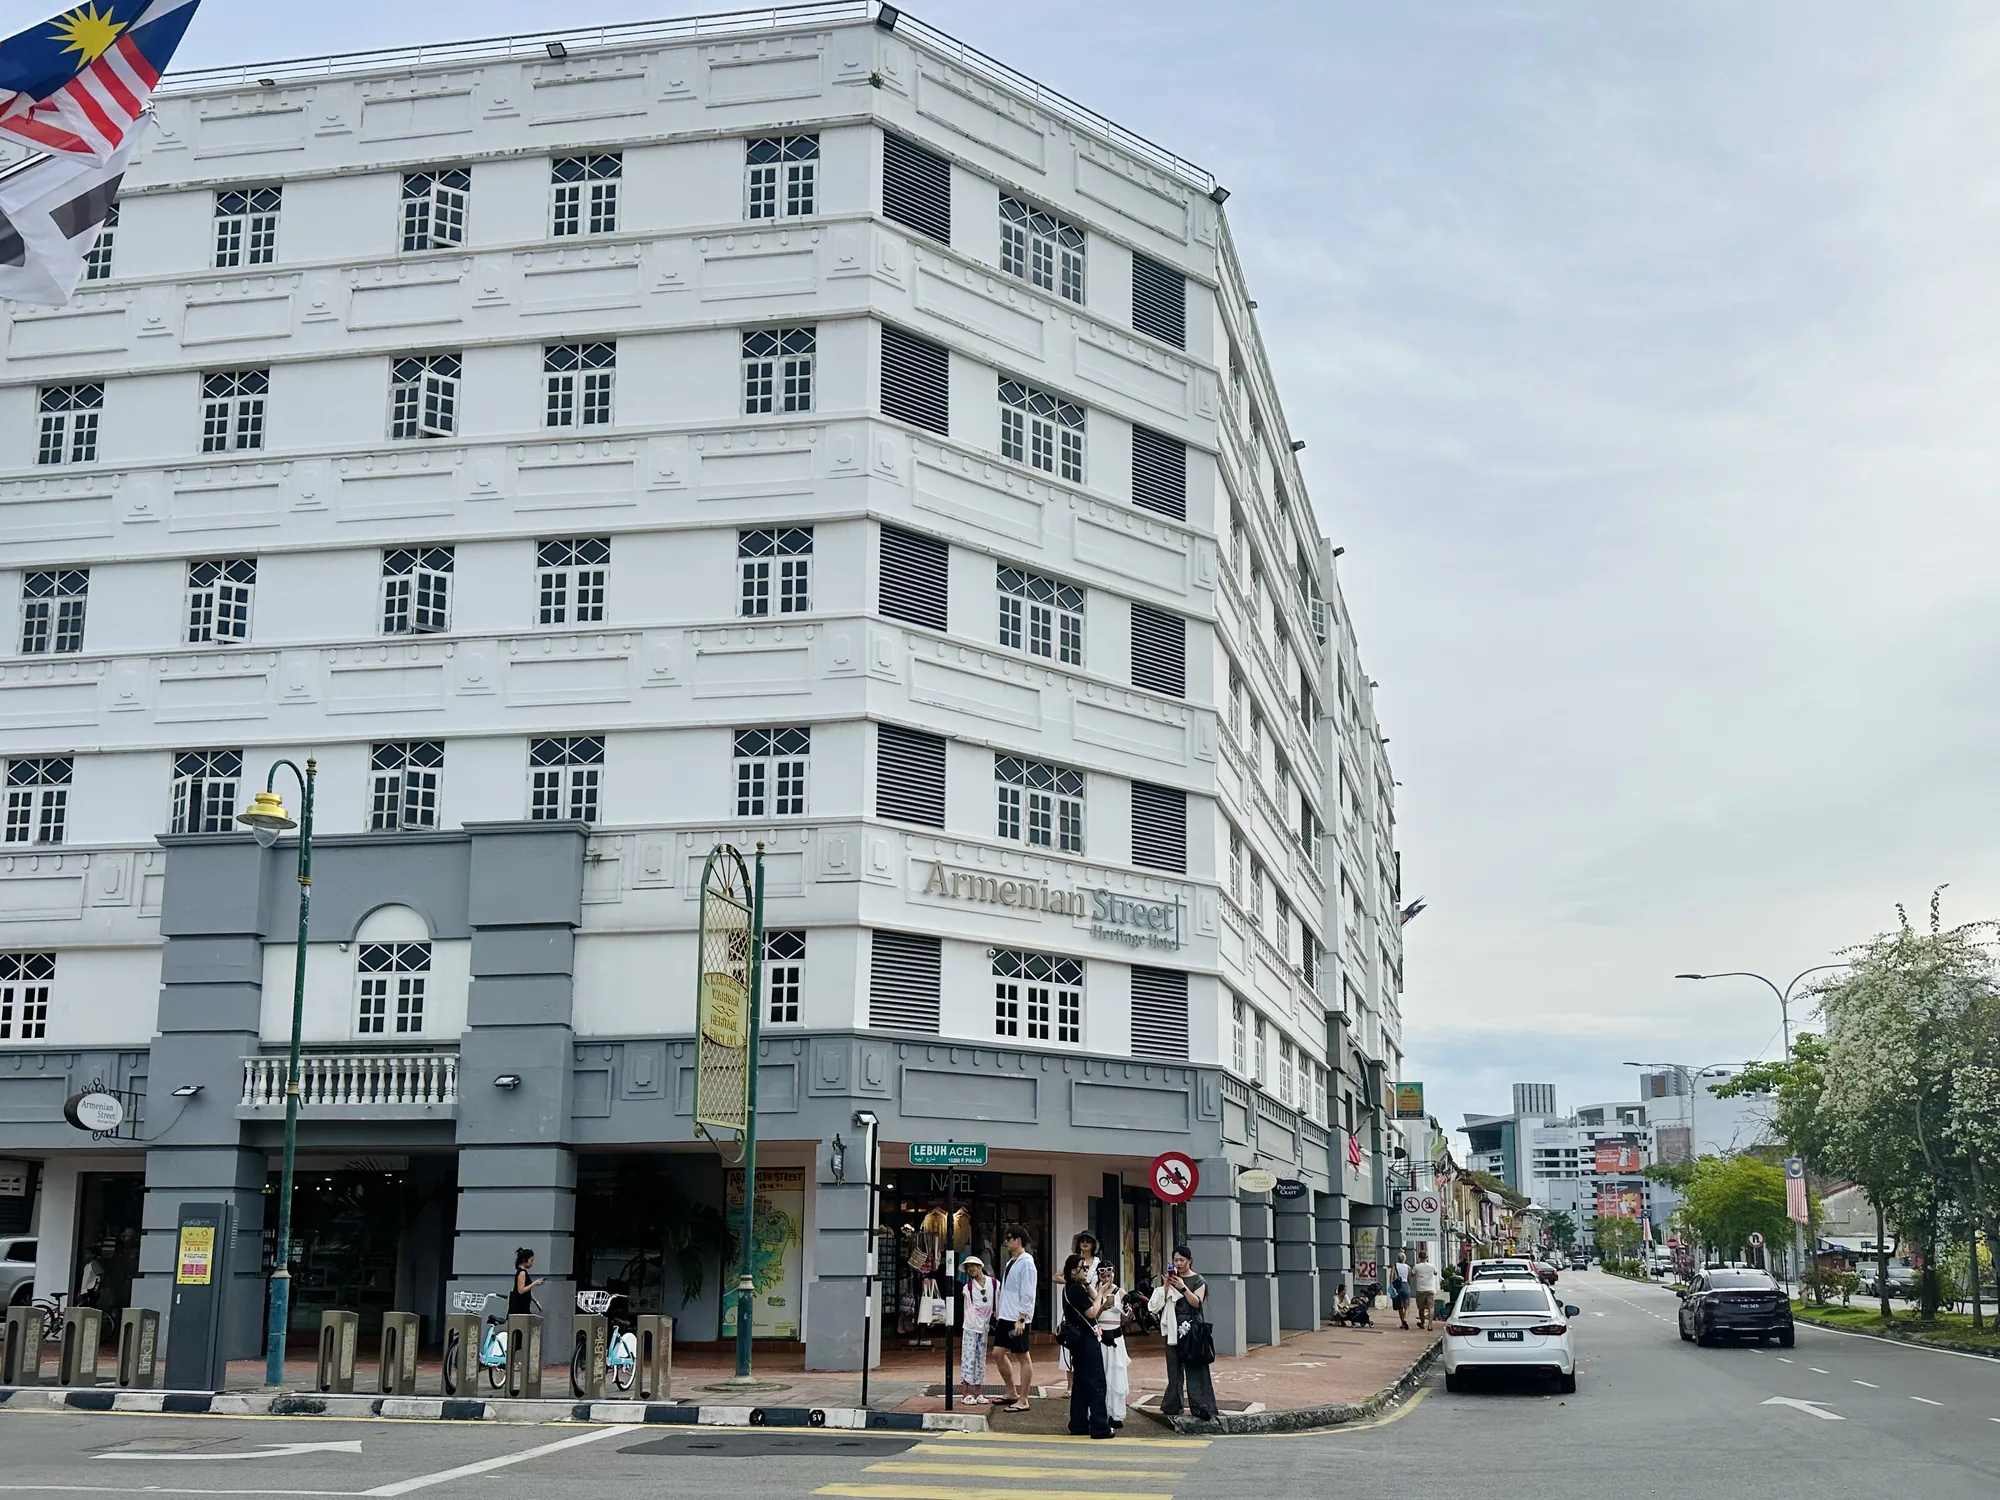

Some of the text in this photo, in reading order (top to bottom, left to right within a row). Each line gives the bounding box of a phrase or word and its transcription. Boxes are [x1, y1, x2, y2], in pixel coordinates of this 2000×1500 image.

[923, 860, 1175, 931] Armenian Street
[1092, 924, 1145, 949] Heritage
[712, 988, 740, 1008] WARISAN
[81, 1100, 114, 1112] Armenian
[97, 1110, 116, 1120] Street
[914, 1145, 977, 1156] LEBUH ACEH
